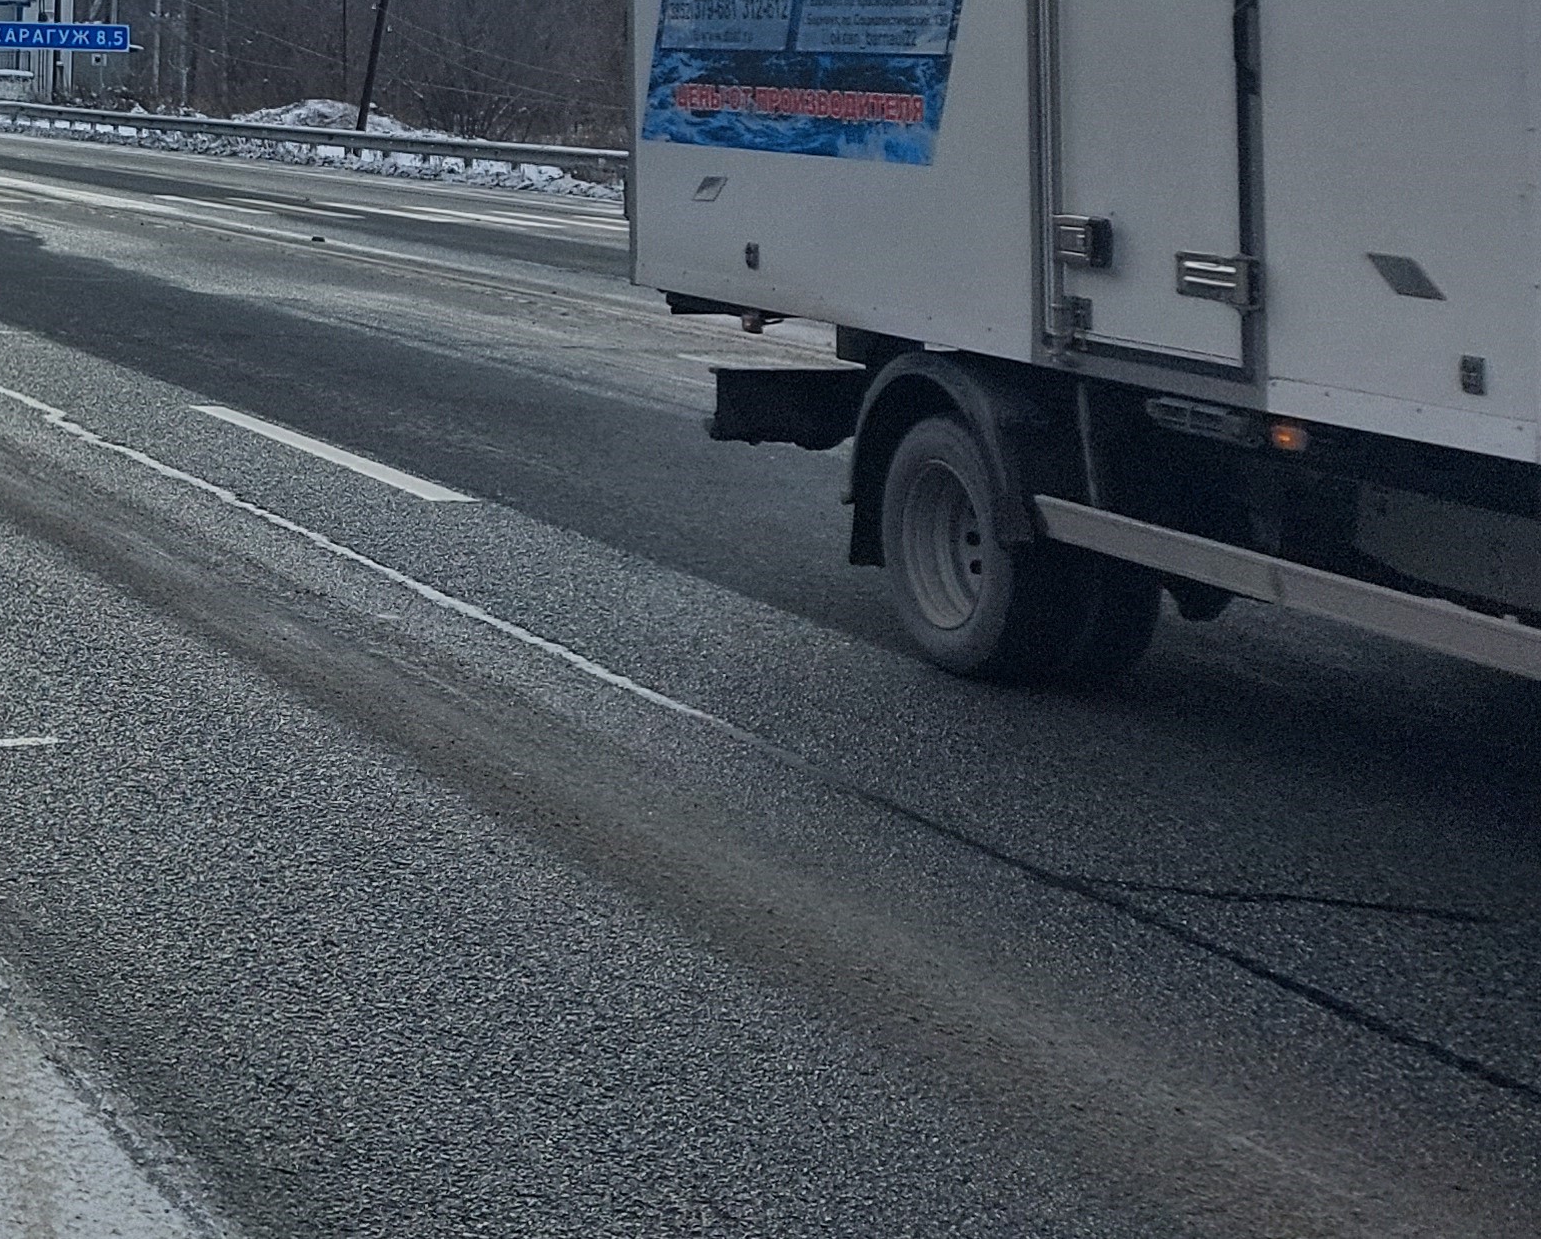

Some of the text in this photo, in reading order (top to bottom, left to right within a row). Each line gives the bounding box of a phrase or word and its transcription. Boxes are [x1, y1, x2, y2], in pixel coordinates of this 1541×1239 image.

[675, 83, 924, 124] ЦЕНЫ ОТ ПРОИЗВОДИТЕЛЯ
